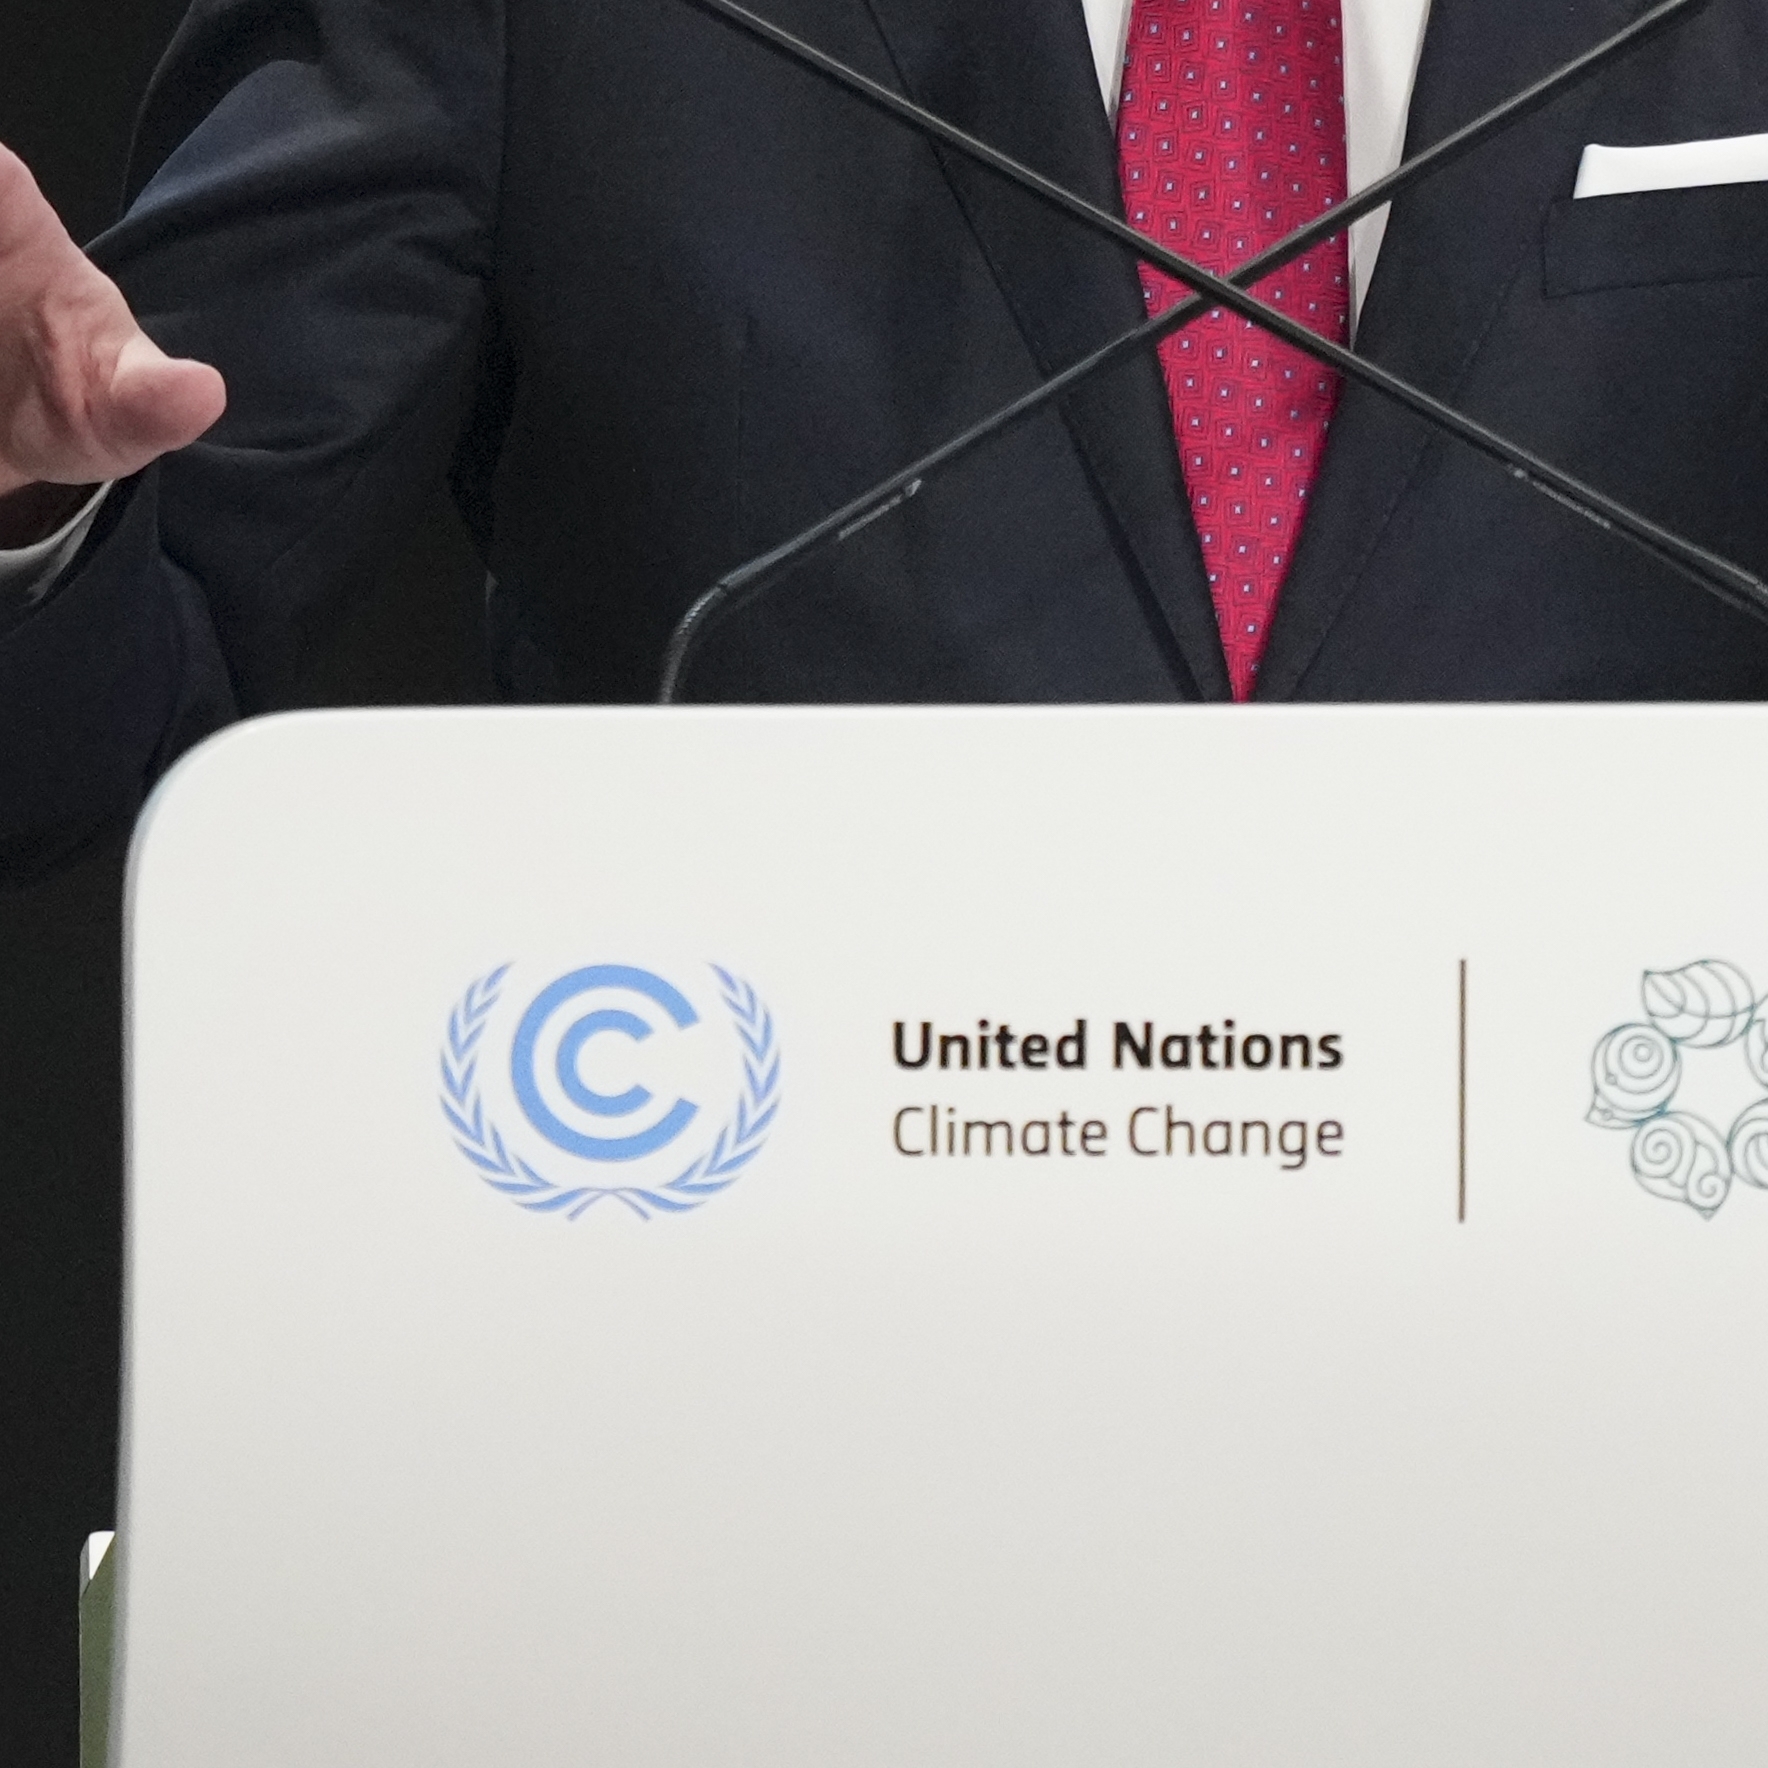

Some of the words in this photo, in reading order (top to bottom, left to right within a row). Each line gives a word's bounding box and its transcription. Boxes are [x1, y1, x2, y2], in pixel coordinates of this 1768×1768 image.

[892, 1018, 1089, 1073] United
[1113, 1018, 1345, 1073] Nations
[892, 1104, 1109, 1159] Climate
[1128, 1103, 1346, 1172] Change
